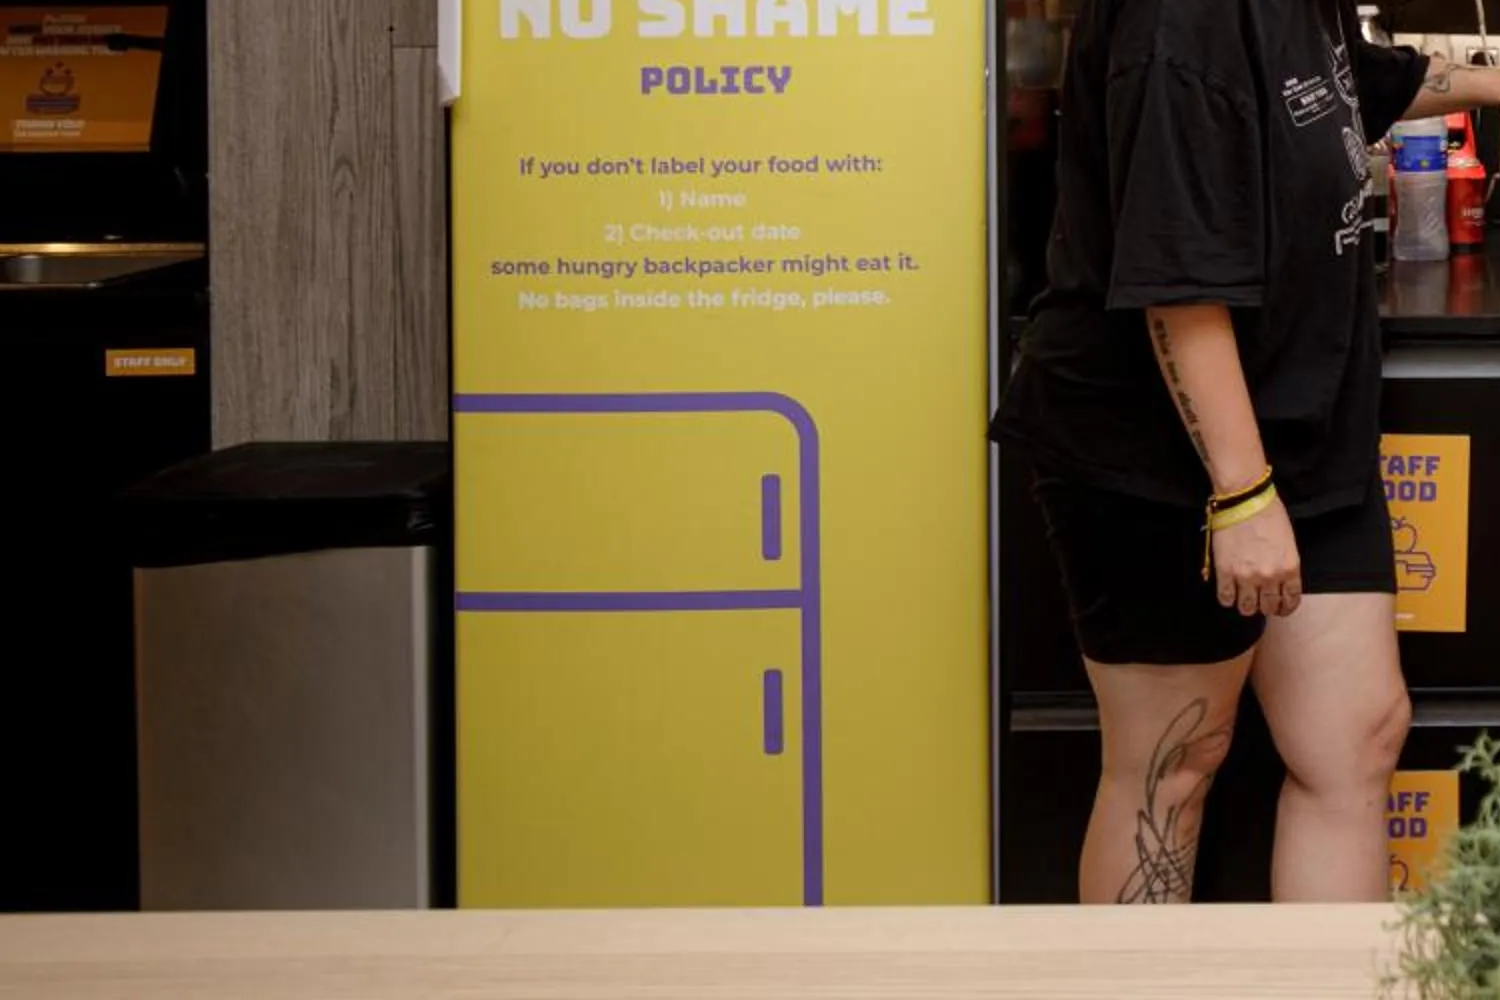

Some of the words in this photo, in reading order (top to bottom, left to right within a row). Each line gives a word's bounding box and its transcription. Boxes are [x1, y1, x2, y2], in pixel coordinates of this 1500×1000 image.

[641, 66, 792, 94] POLICY
[520, 157, 535, 174] If
[540, 160, 579, 178] you
[587, 157, 643, 174] don't
[651, 157, 704, 174] label
[711, 160, 761, 177] your
[768, 156, 819, 173] food
[826, 155, 882, 172] with:
[680, 191, 746, 207] Name
[604, 224, 623, 244] 2)
[630, 223, 743, 241] Check-out
[752, 223, 802, 240] date
[491, 261, 549, 274] some
[557, 257, 637, 278] hungry
[644, 256, 774, 278] backpacker
[782, 253, 849, 275] might
[856, 256, 891, 271] eat
[898, 252, 919, 270] it.
[519, 292, 549, 309] No
[555, 291, 608, 312] bags
[614, 289, 681, 308] inside
[688, 289, 724, 307] the
[731, 288, 806, 310] fridge,
[813, 288, 891, 307] please.
[1379, 456, 1440, 476] AFF
[1382, 480, 1437, 502] OOD
